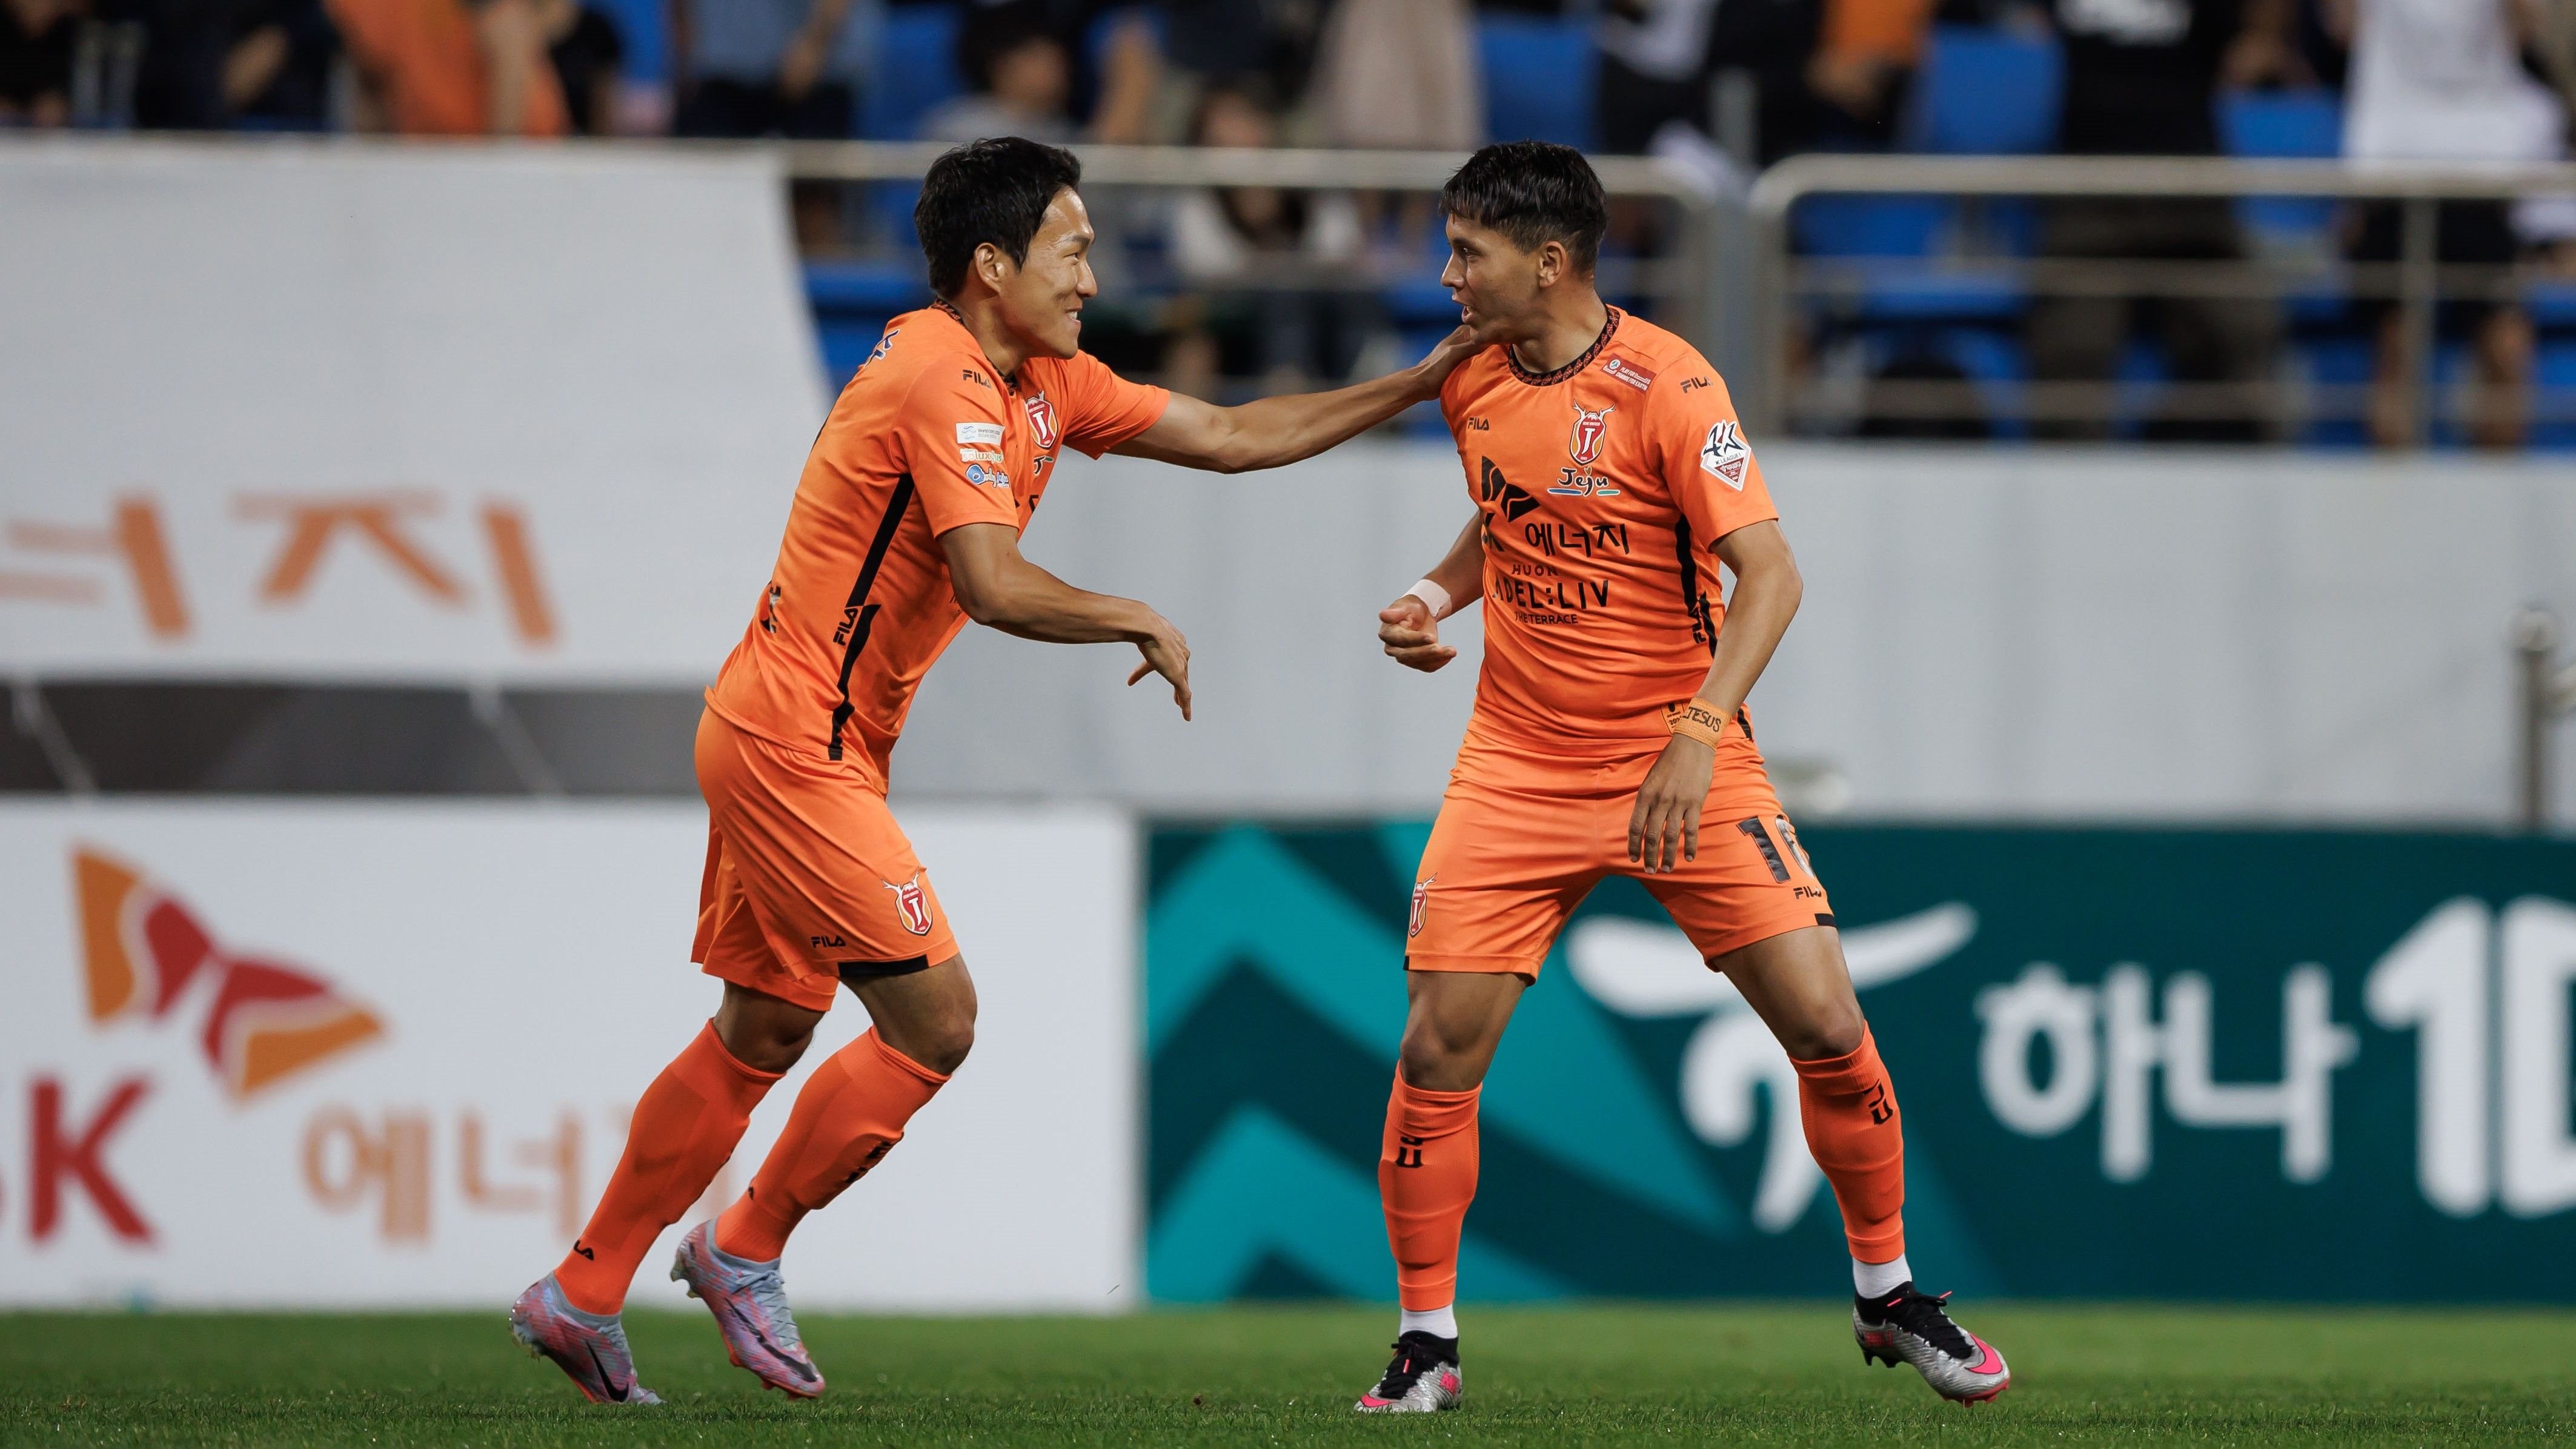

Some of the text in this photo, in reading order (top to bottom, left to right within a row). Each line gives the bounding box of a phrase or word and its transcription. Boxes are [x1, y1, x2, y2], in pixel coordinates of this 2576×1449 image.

[962, 370, 992, 389] FILA
[1681, 376, 1713, 394] FILA
[1468, 417, 1490, 431] FILA
[1558, 466, 1609, 496] Jeju
[1524, 522, 1630, 558] 에너지
[1512, 563, 1559, 576] HUON
[833, 606, 858, 647] FILA
[1682, 706, 1722, 733] JESUS
[1793, 886, 1822, 900] FILA
[811, 935, 846, 948] FILA
[1972, 962, 2360, 1185] 하나
[0, 1073, 159, 1247] K
